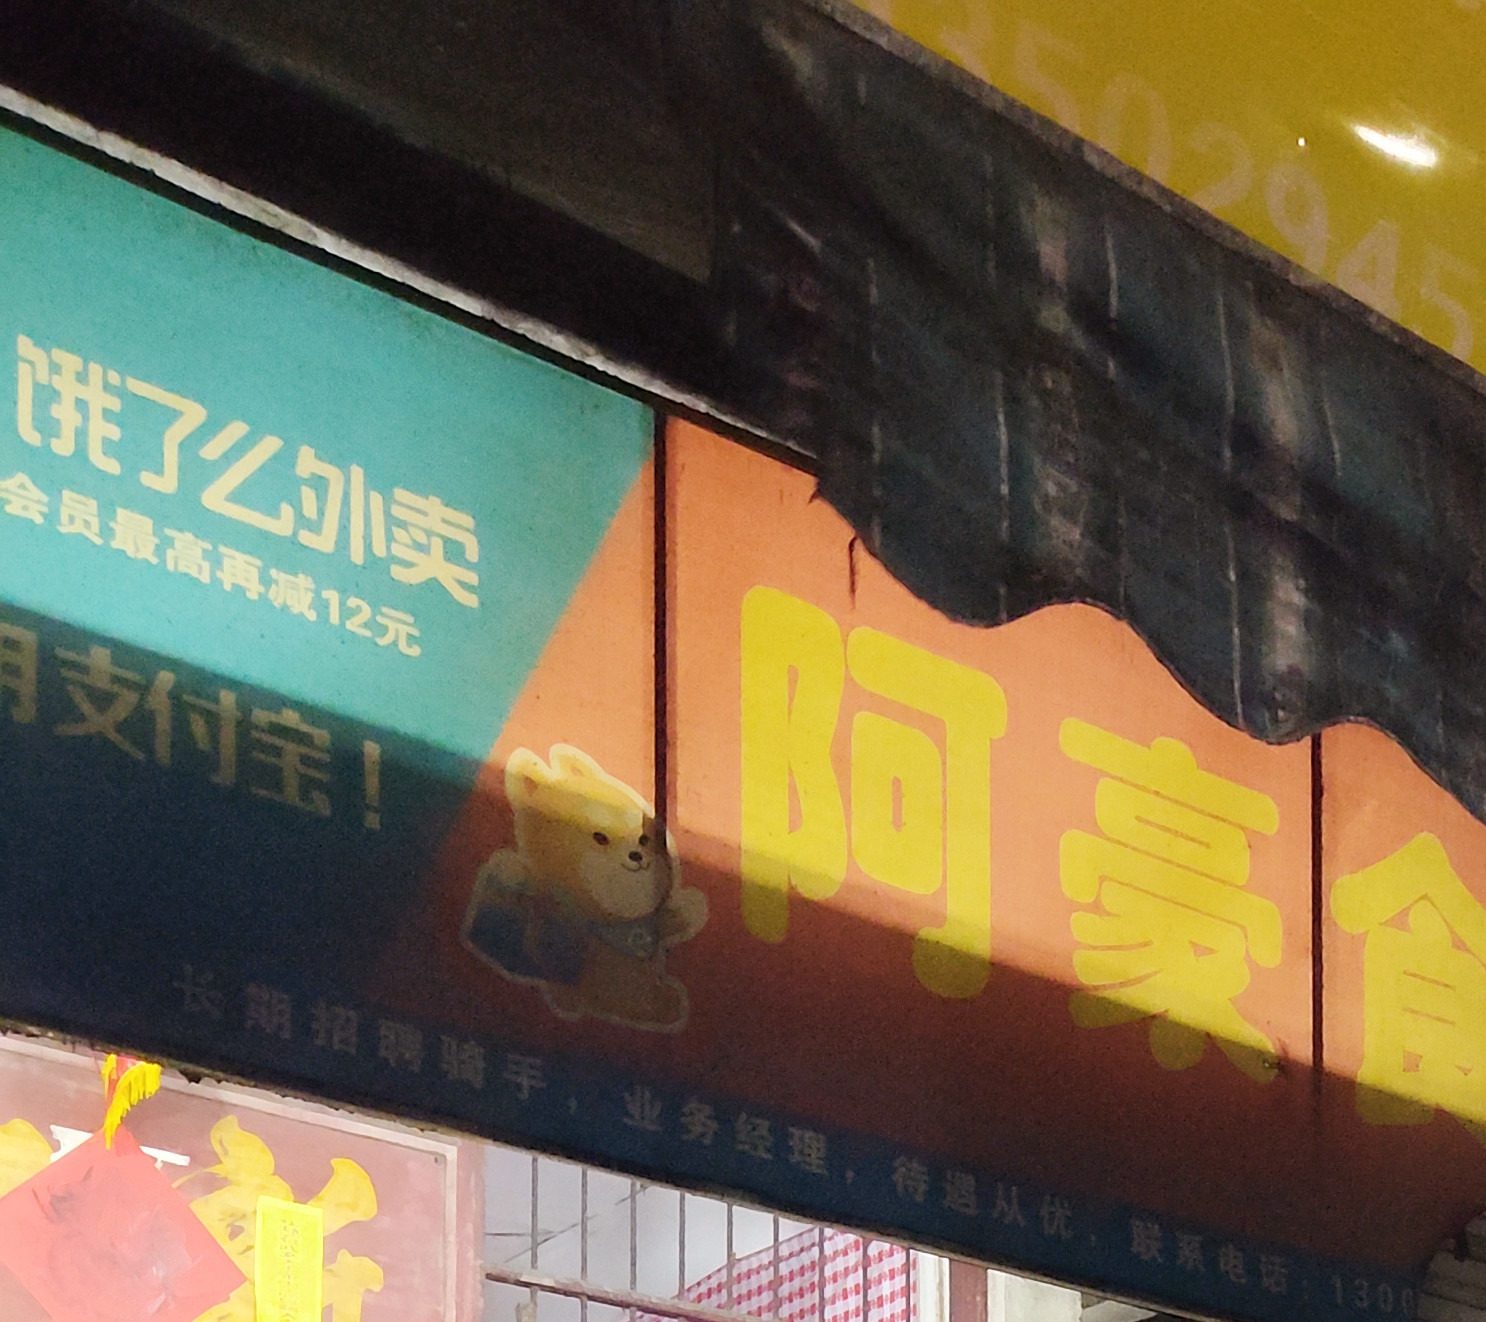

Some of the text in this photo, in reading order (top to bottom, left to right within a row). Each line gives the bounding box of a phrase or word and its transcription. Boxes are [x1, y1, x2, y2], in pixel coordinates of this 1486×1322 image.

[0, 472, 422, 657] 会员最高再减12元
[17, 334, 480, 608] 饿了么外卖
